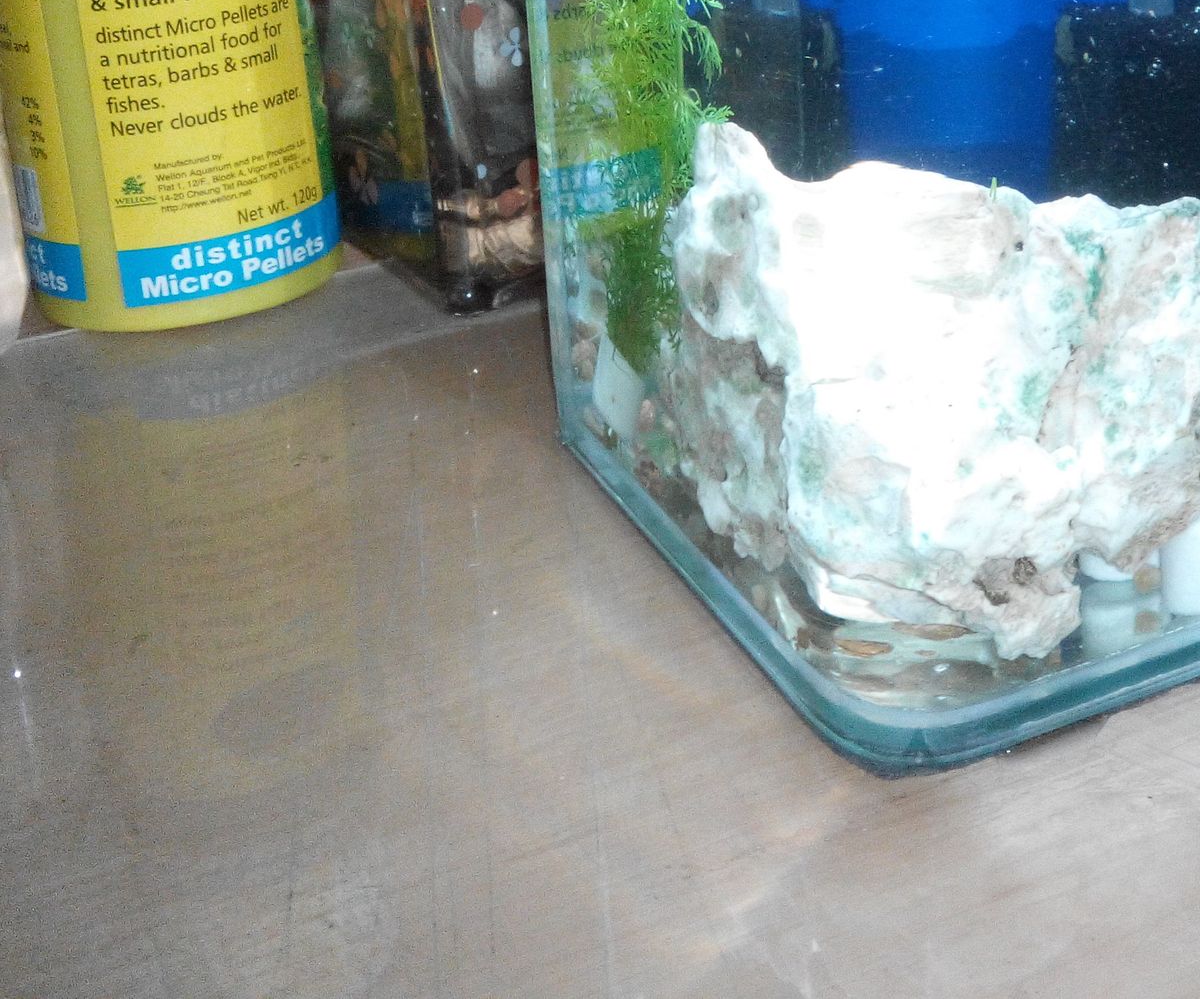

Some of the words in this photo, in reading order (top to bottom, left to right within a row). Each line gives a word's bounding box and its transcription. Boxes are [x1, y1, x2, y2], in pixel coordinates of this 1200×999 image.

[95, 23, 163, 44] distinct
[165, 16, 217, 37] Micro
[220, 4, 269, 27] Pellets
[100, 54, 110, 67] a
[117, 36, 216, 66] nutritional
[220, 26, 259, 50] food
[262, 22, 283, 39] for
[102, 73, 163, 91] tetras,
[167, 61, 220, 85] barbs
[224, 56, 237, 73] &
[240, 43, 279, 69] small
[105, 95, 166, 114] fishes.
[110, 119, 164, 137] Never
[170, 105, 228, 130] clouds
[231, 99, 259, 118] the
[262, 85, 303, 110] water.
[237, 206, 263, 224] Net
[268, 199, 289, 215] wt.
[292, 185, 318, 208] 120g
[140, 269, 233, 299] Micro
[241, 235, 325, 282] Pellets
[171, 218, 303, 271] distinct
